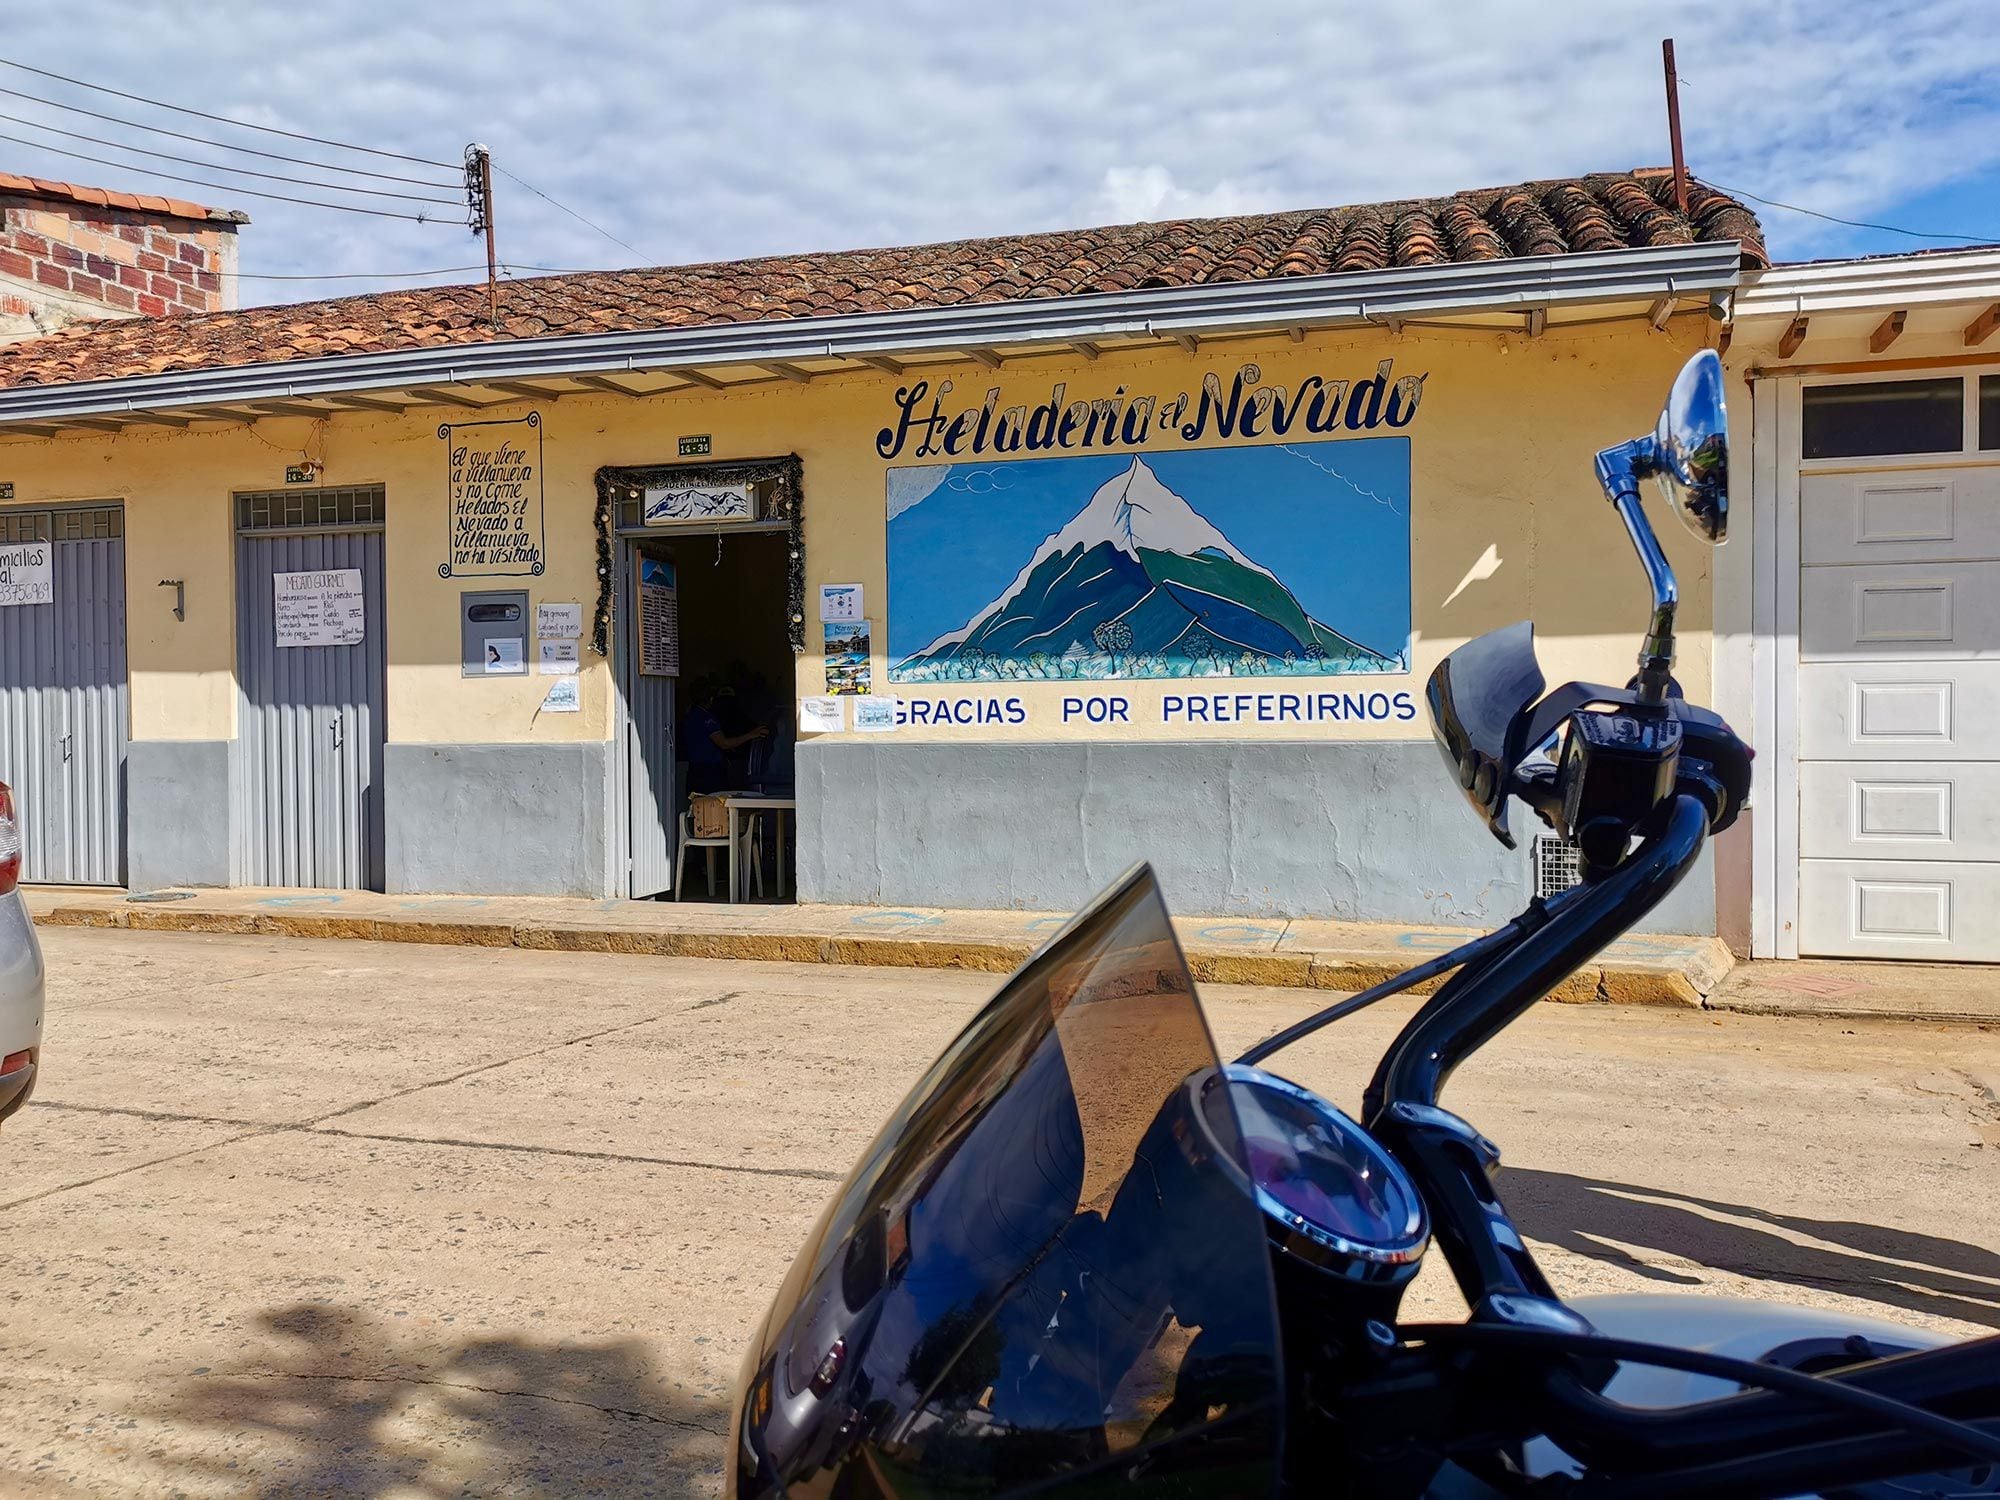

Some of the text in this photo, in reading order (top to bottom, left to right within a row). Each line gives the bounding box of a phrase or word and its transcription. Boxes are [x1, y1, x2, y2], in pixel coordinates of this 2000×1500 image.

[1181, 359, 1429, 441] Nevado
[452, 446, 467, 466] El
[470, 451, 492, 470] que
[452, 469, 462, 482] a
[455, 485, 463, 498] y
[466, 484, 481, 499] no
[456, 496, 510, 515] Helados
[457, 514, 523, 532] Nevado a
[455, 549, 470, 564] no
[895, 697, 1026, 725] GRACIAS
[1063, 697, 1130, 723] POR
[1162, 692, 1418, 722] PREFERIRNOS
